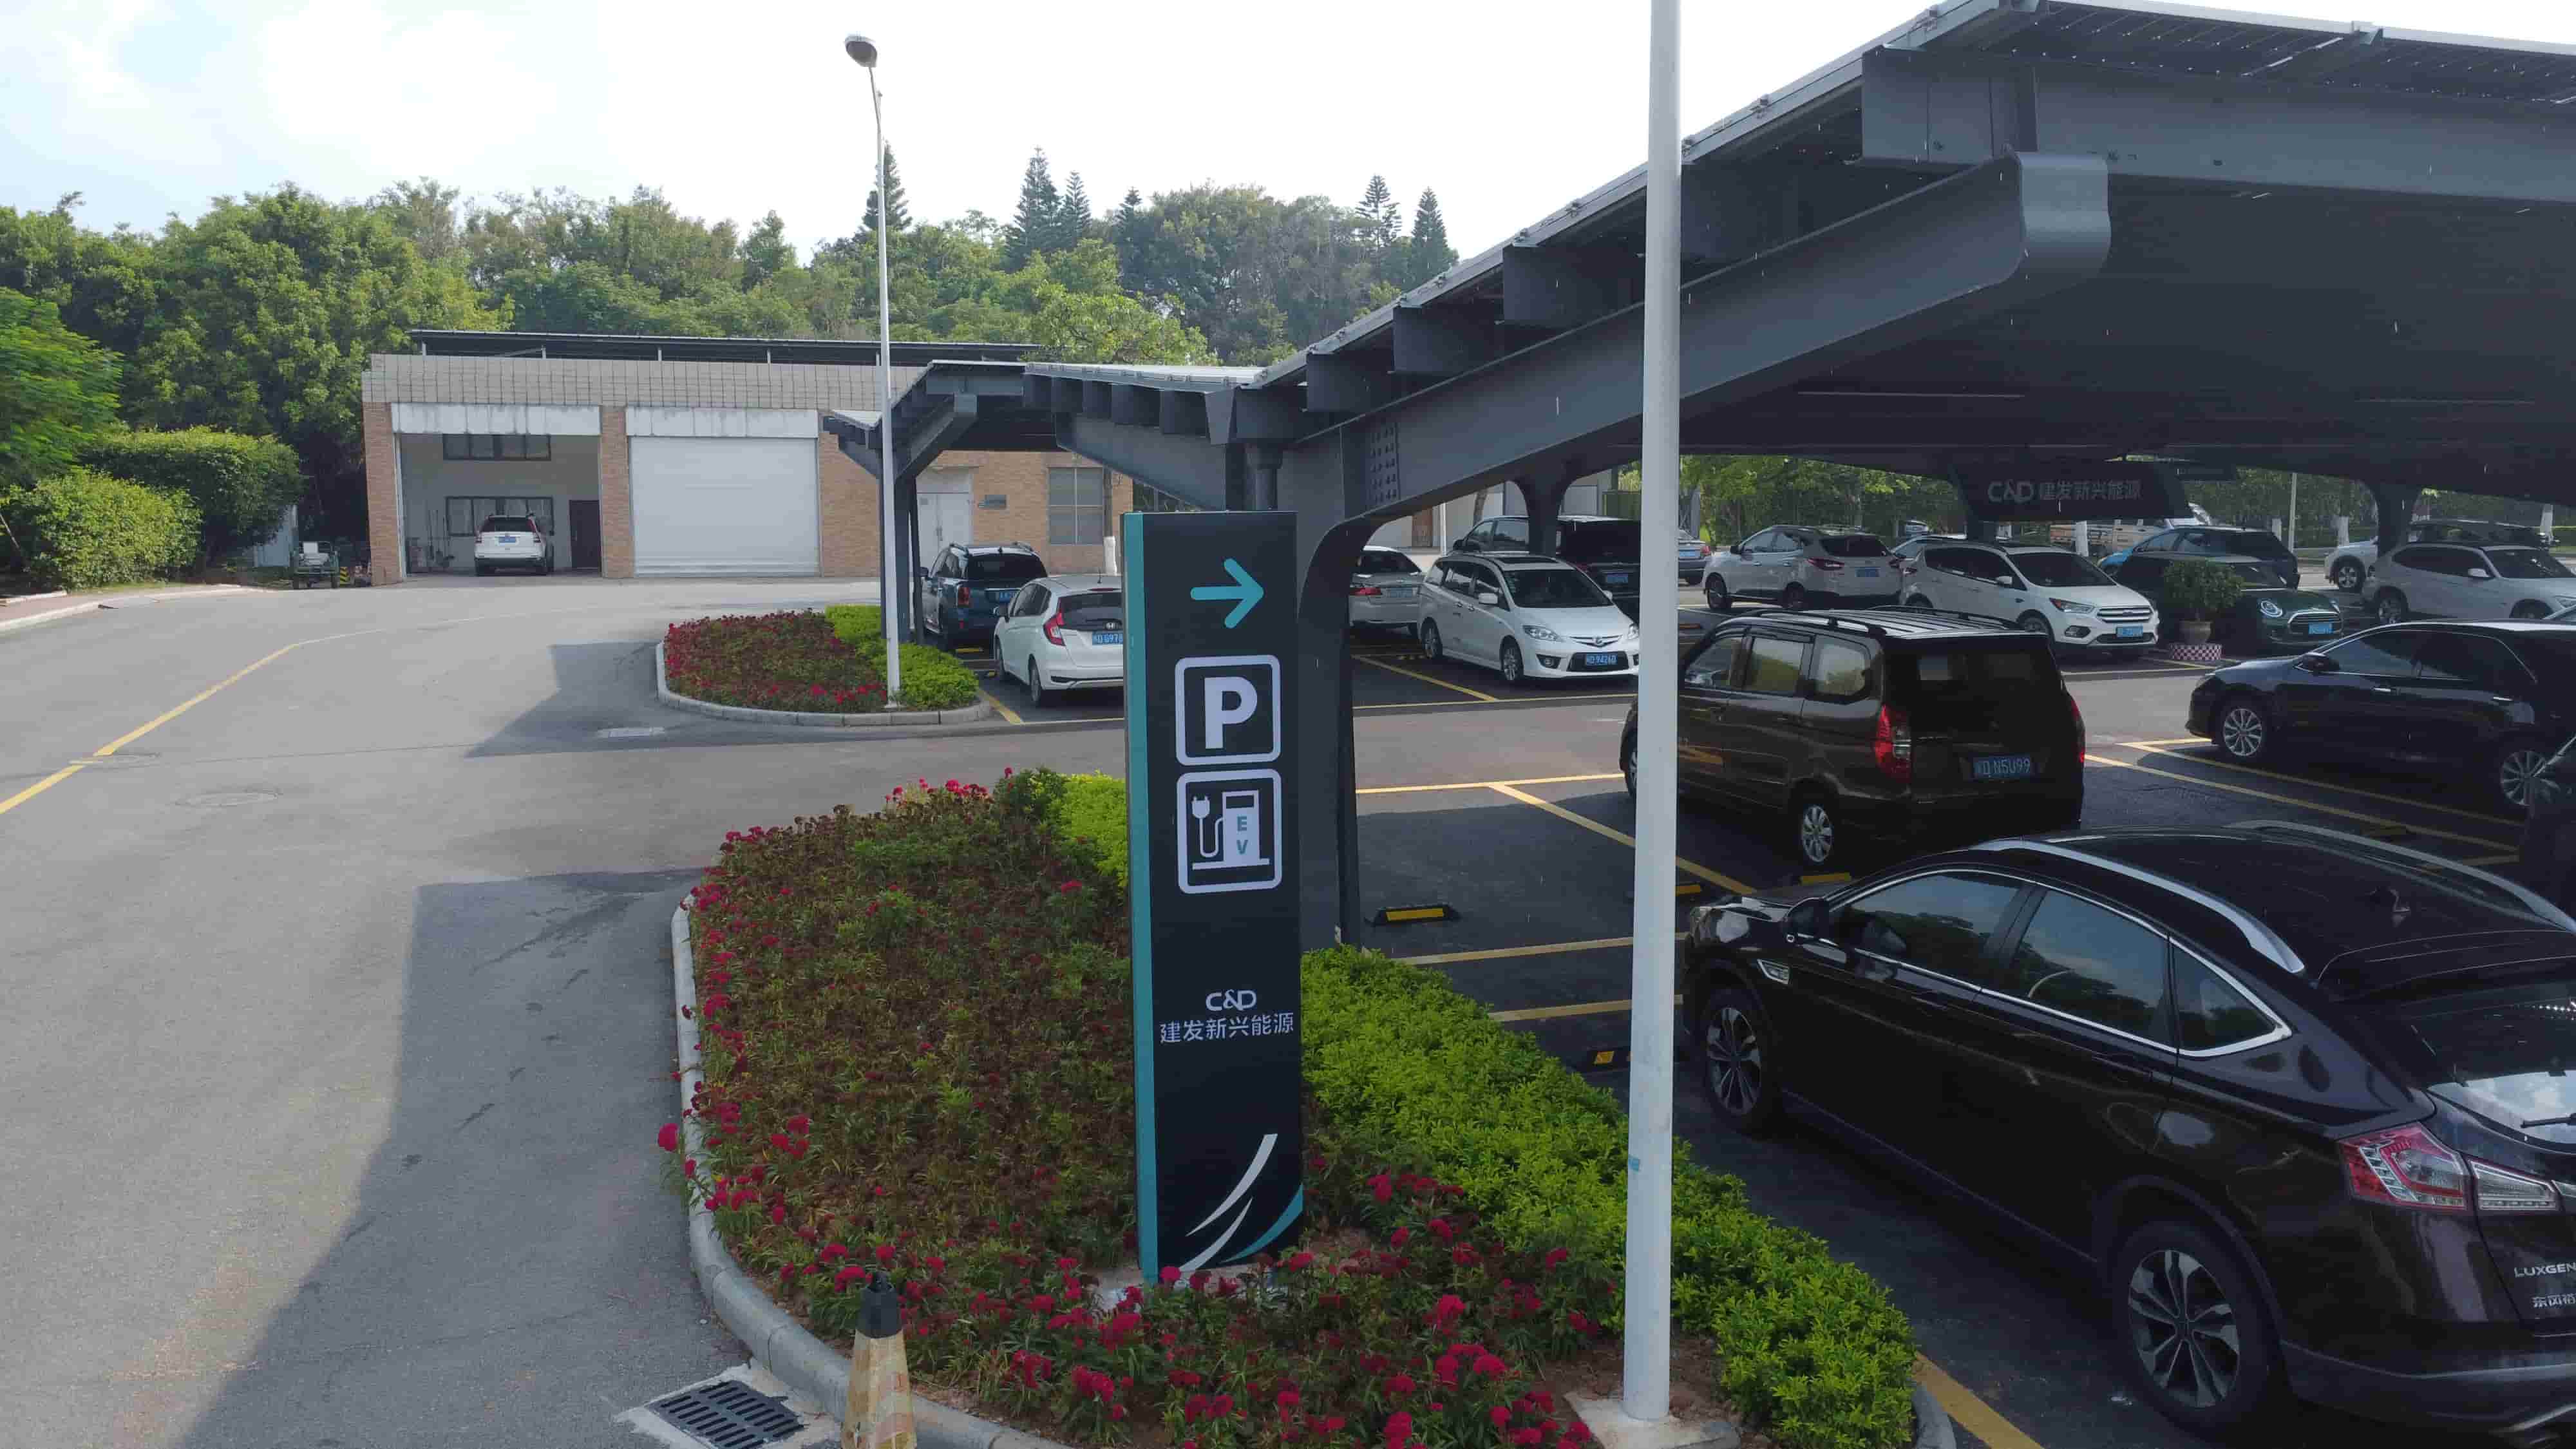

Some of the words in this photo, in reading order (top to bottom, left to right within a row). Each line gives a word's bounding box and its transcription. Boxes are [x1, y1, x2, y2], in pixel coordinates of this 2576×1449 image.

[2040, 480, 2143, 500] 建发新兴能源
[1204, 676, 1258, 750] P
[1206, 989, 1257, 1011] C&D
[1159, 1012, 1294, 1044] 建发新兴能源
